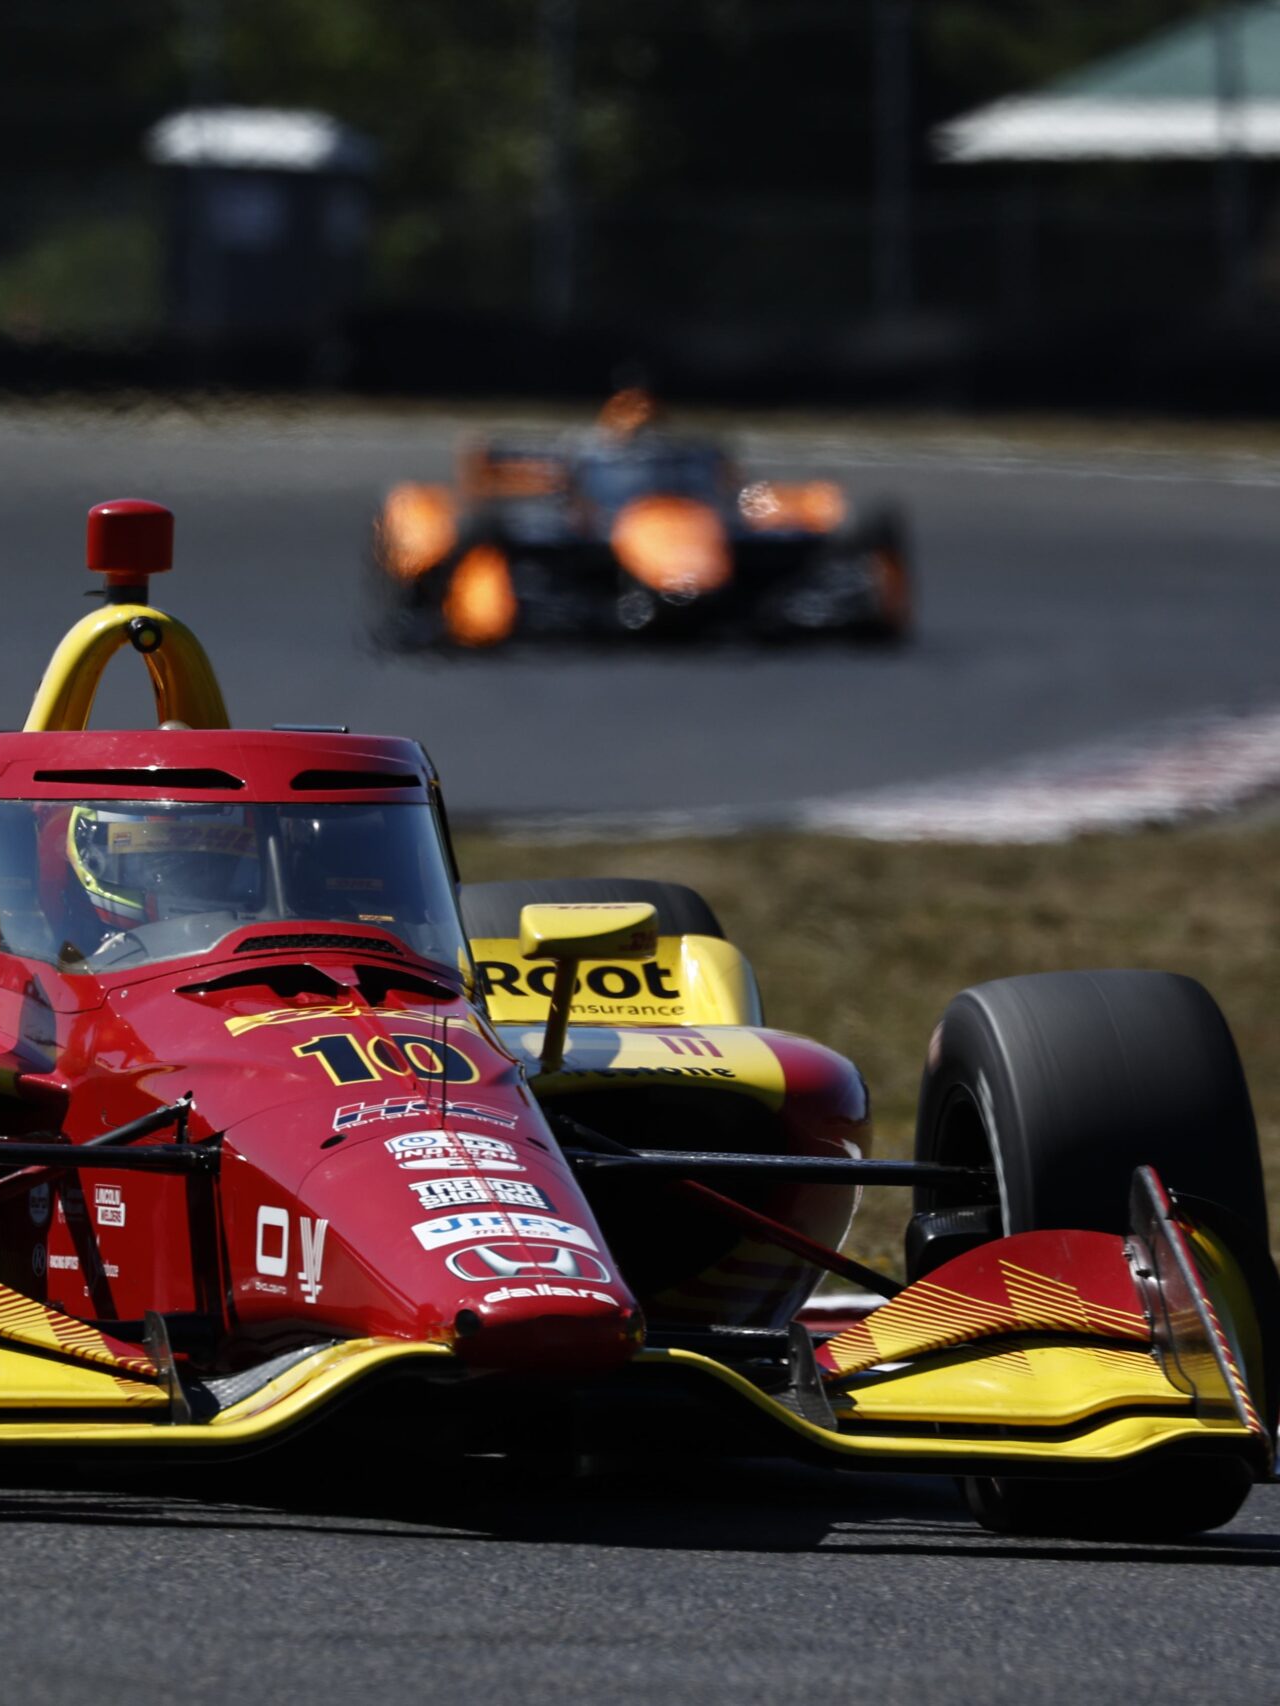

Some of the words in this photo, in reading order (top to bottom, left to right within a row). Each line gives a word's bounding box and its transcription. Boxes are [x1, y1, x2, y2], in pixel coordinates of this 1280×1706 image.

[476, 960, 681, 1000] Root
[569, 1004, 686, 1017] nsurance
[291, 1033, 481, 1087] 10
[430, 1217, 576, 1235] JIFFY
[483, 1284, 620, 1306] dallara
